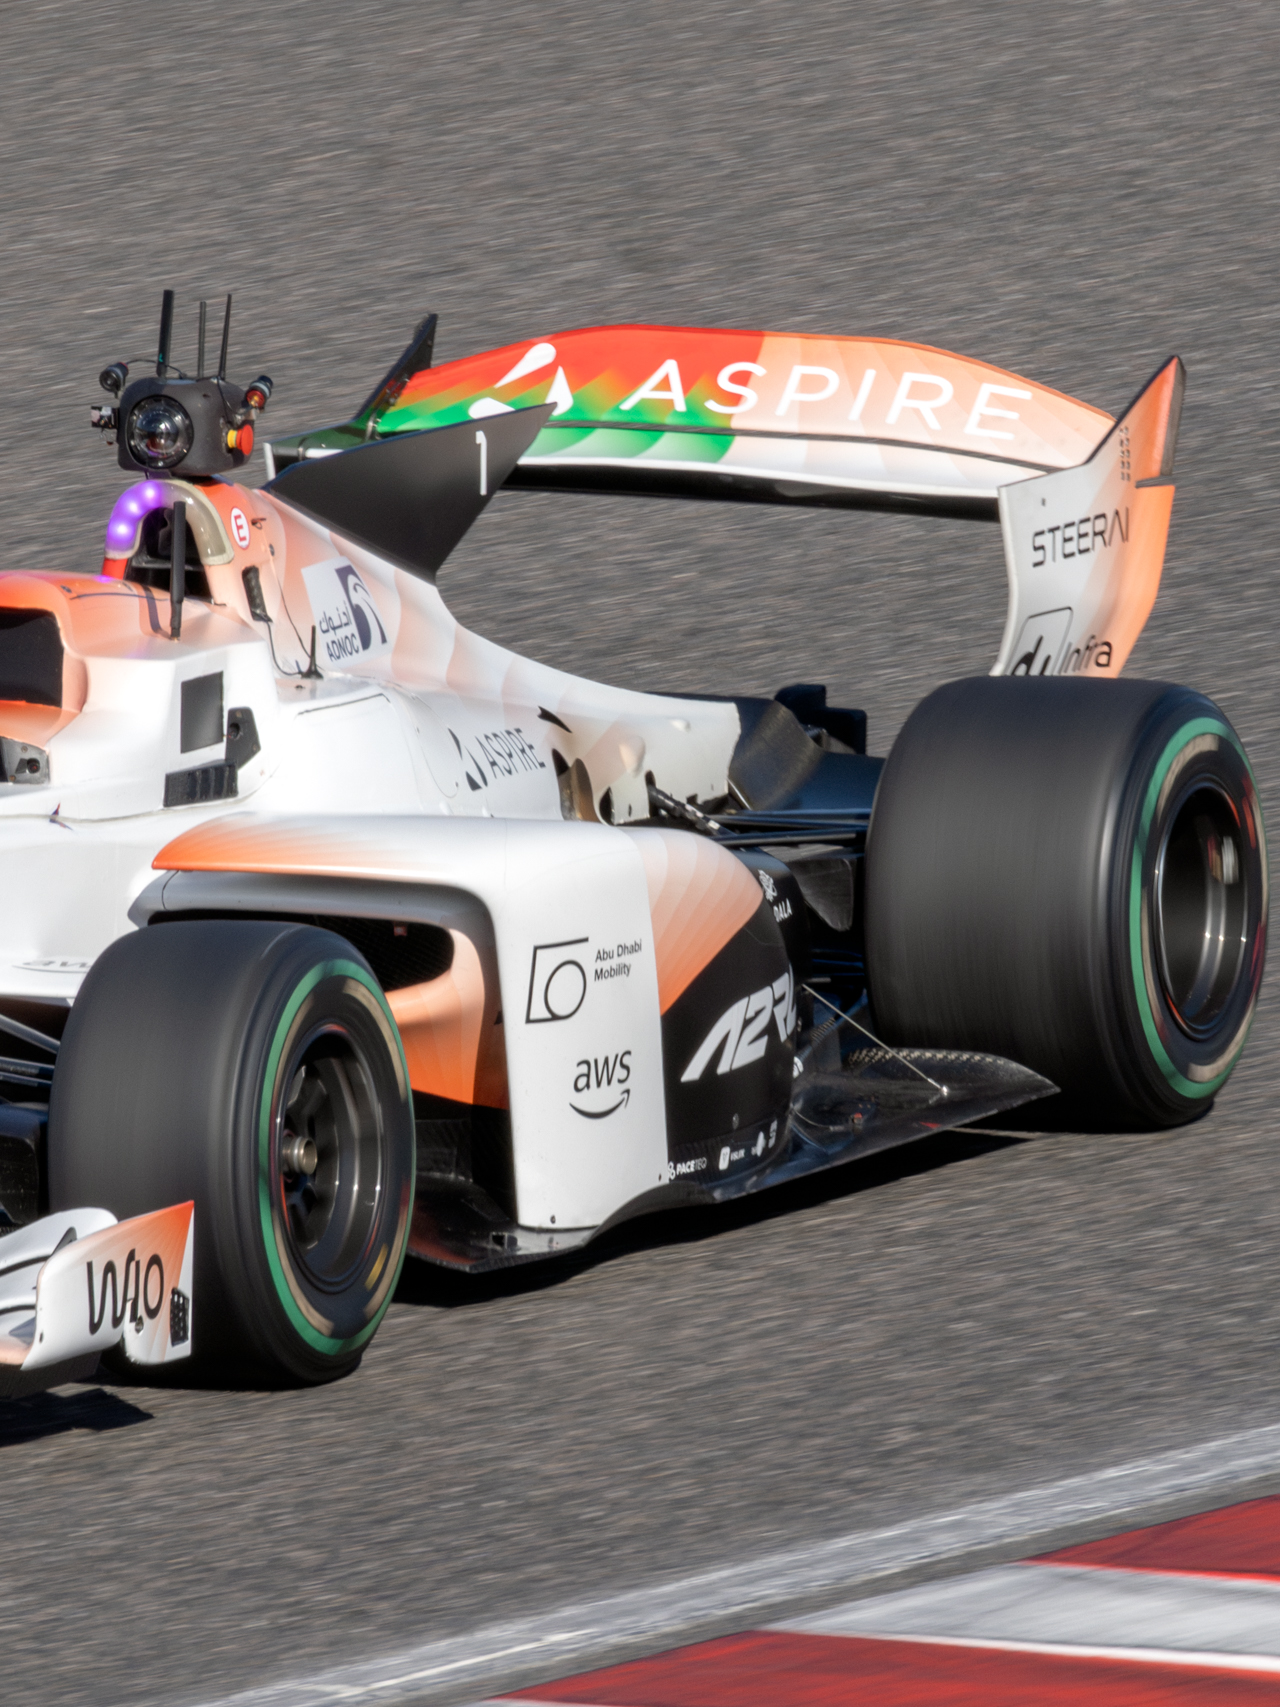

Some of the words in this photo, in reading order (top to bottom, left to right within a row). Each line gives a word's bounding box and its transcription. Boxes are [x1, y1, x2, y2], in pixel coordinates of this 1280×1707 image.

[619, 358, 1034, 440] ASPIRE
[475, 429, 487, 496] 1
[234, 514, 247, 542] E
[326, 633, 360, 662] ADNOC
[475, 728, 547, 780] ASPIRE
[595, 949, 614, 963] Abu
[617, 939, 643, 958] Dhabi
[594, 962, 632, 982] Mobility
[573, 1049, 632, 1093] aws
